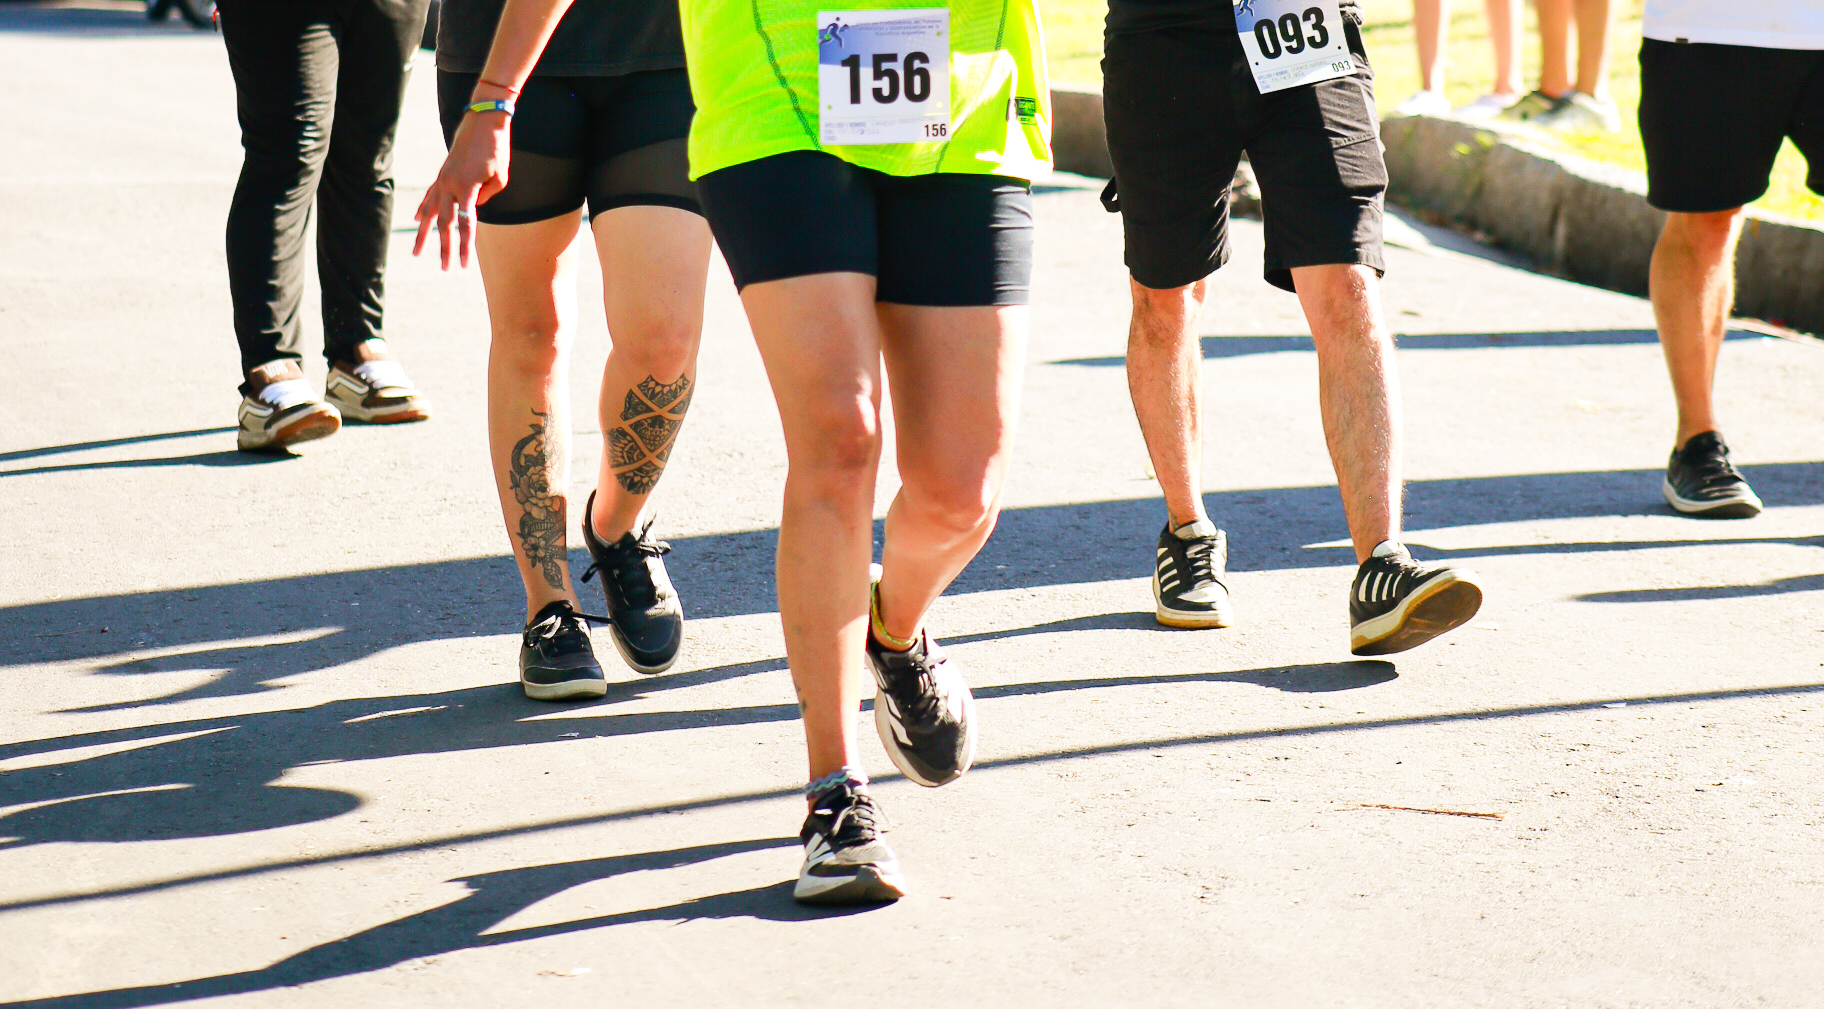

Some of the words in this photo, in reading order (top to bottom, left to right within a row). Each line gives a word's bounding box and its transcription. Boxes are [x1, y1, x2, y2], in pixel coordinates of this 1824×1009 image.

[1254, 6, 1329, 60] 093
[841, 51, 931, 105] 156
[1331, 60, 1351, 72] 093
[924, 123, 947, 138] 156
